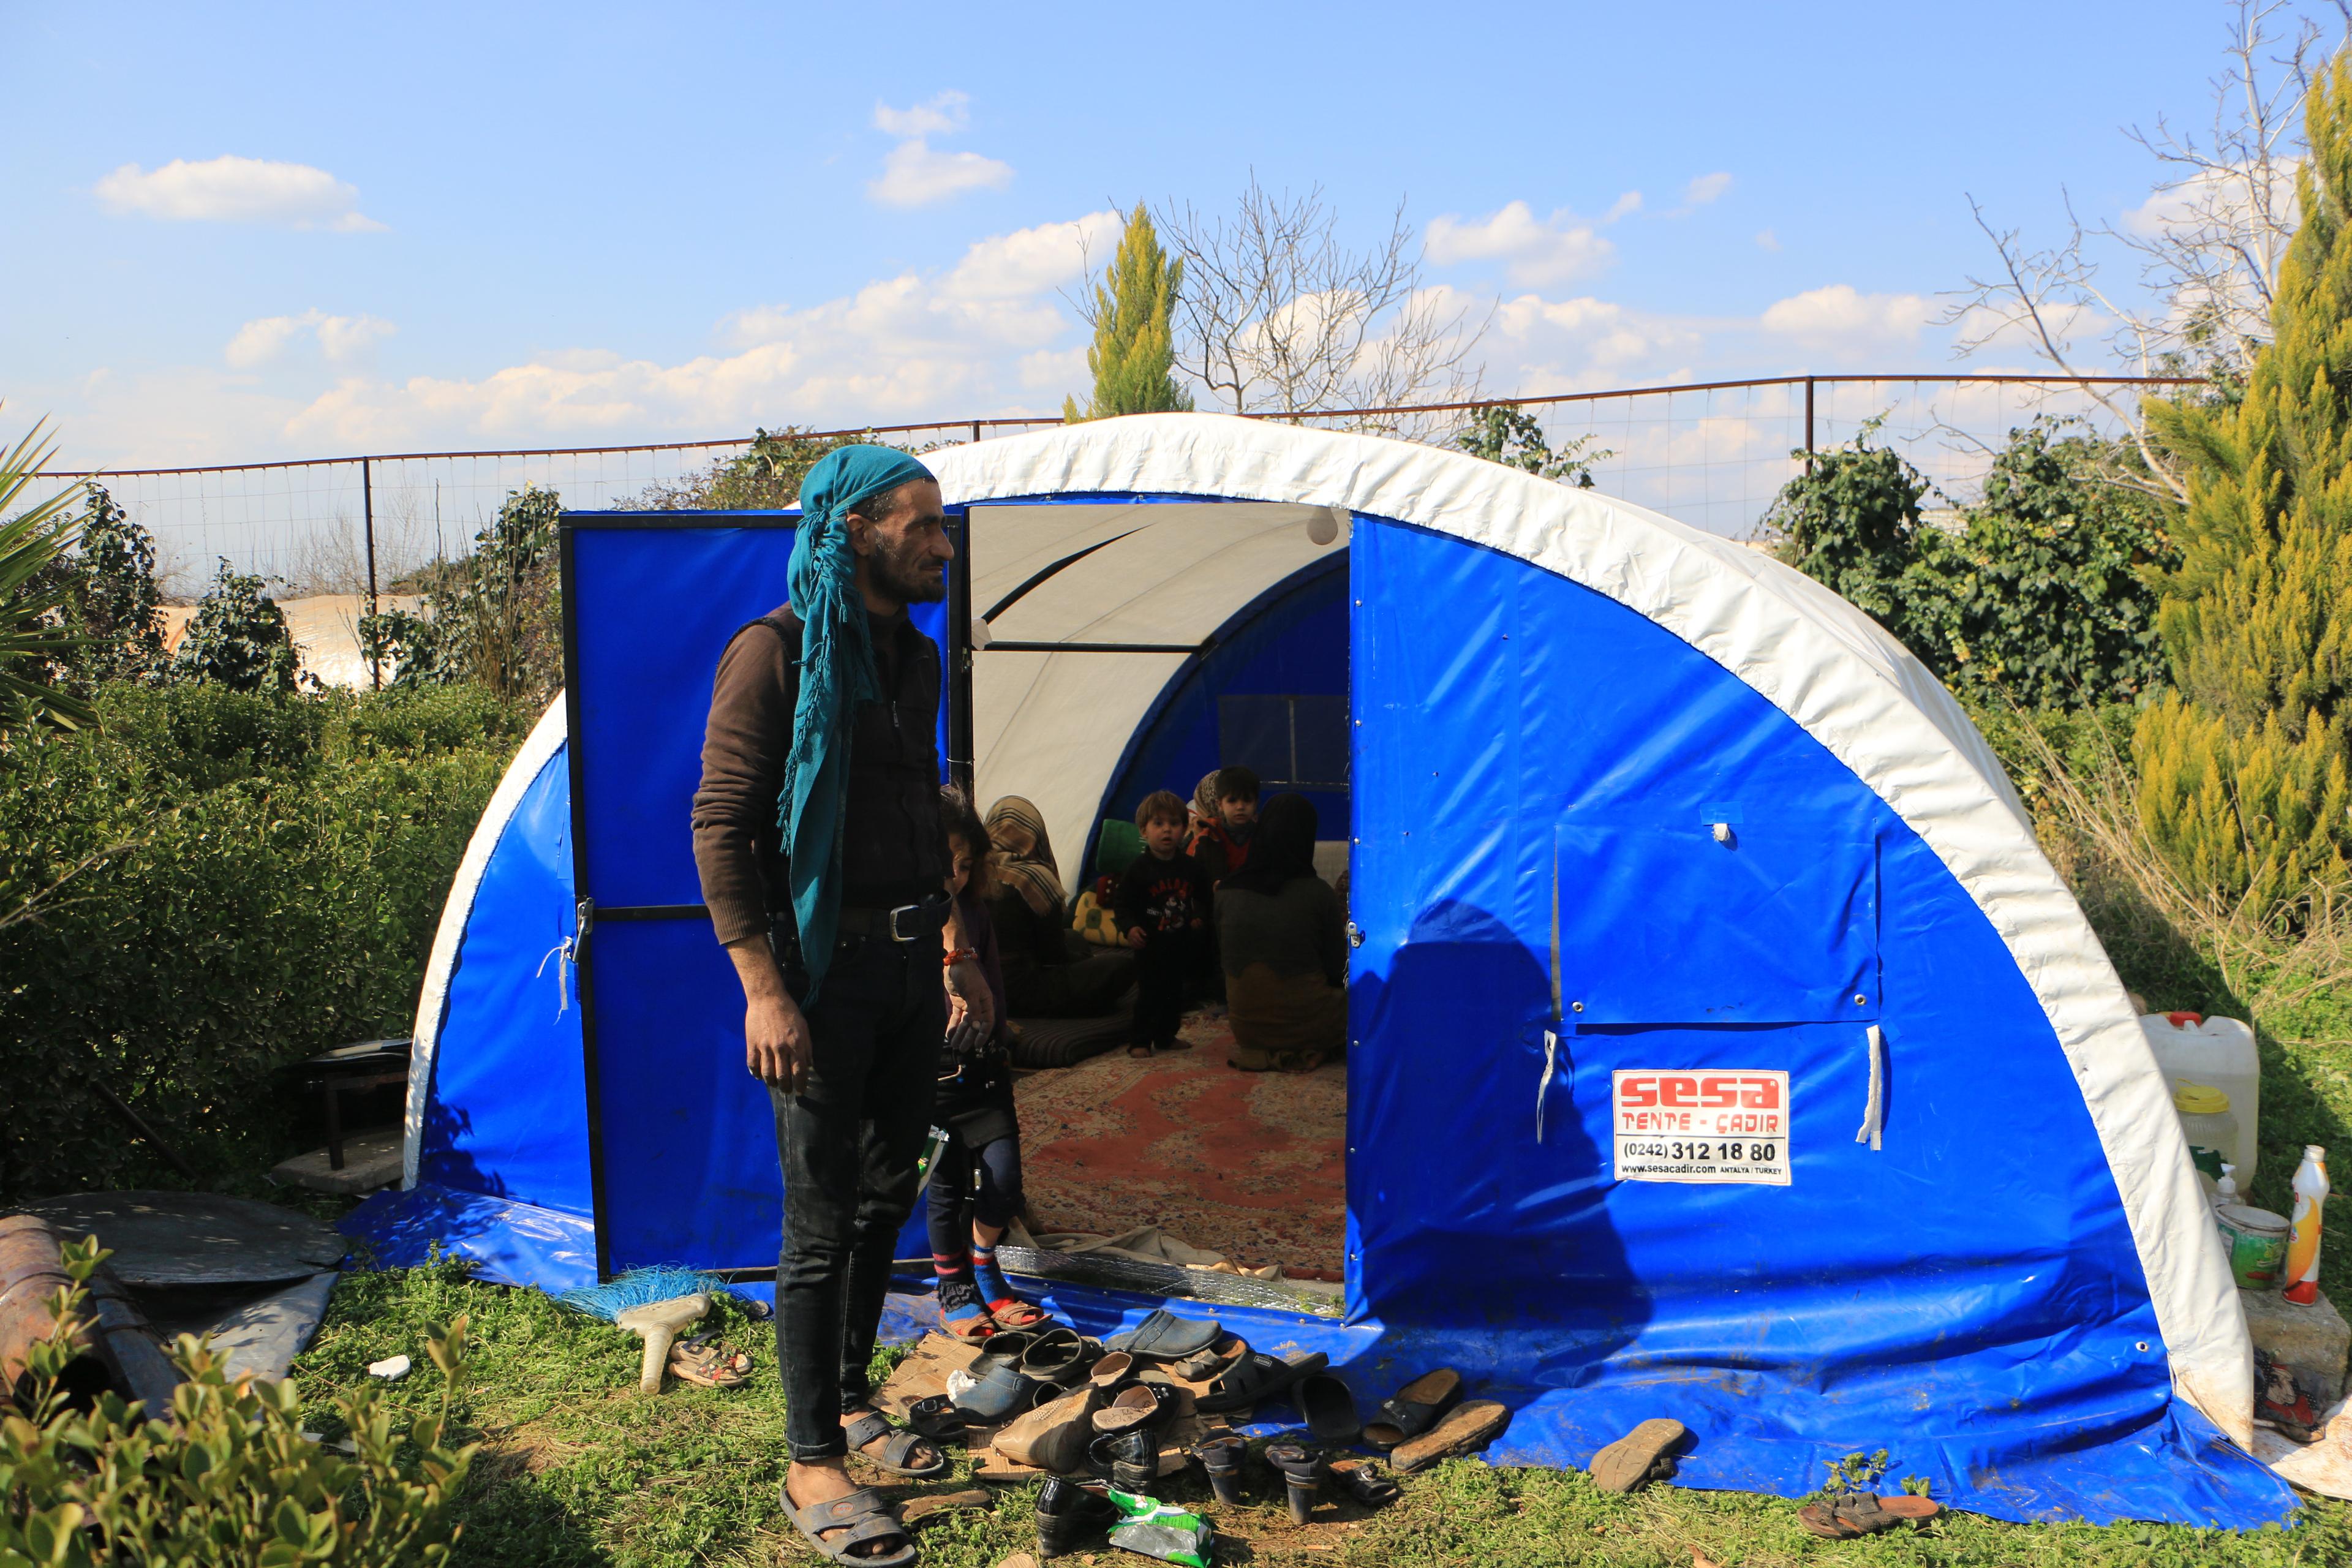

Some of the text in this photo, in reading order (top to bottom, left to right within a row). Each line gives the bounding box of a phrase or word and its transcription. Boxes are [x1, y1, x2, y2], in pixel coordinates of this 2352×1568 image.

[1621, 1112, 1691, 1130] TENTE
[1716, 1114, 1777, 1133] ÇADIR
[1624, 1142, 1775, 1161] (0242) 312 18 80
[1621, 1164, 1716, 1174] www.sesacadir.com
